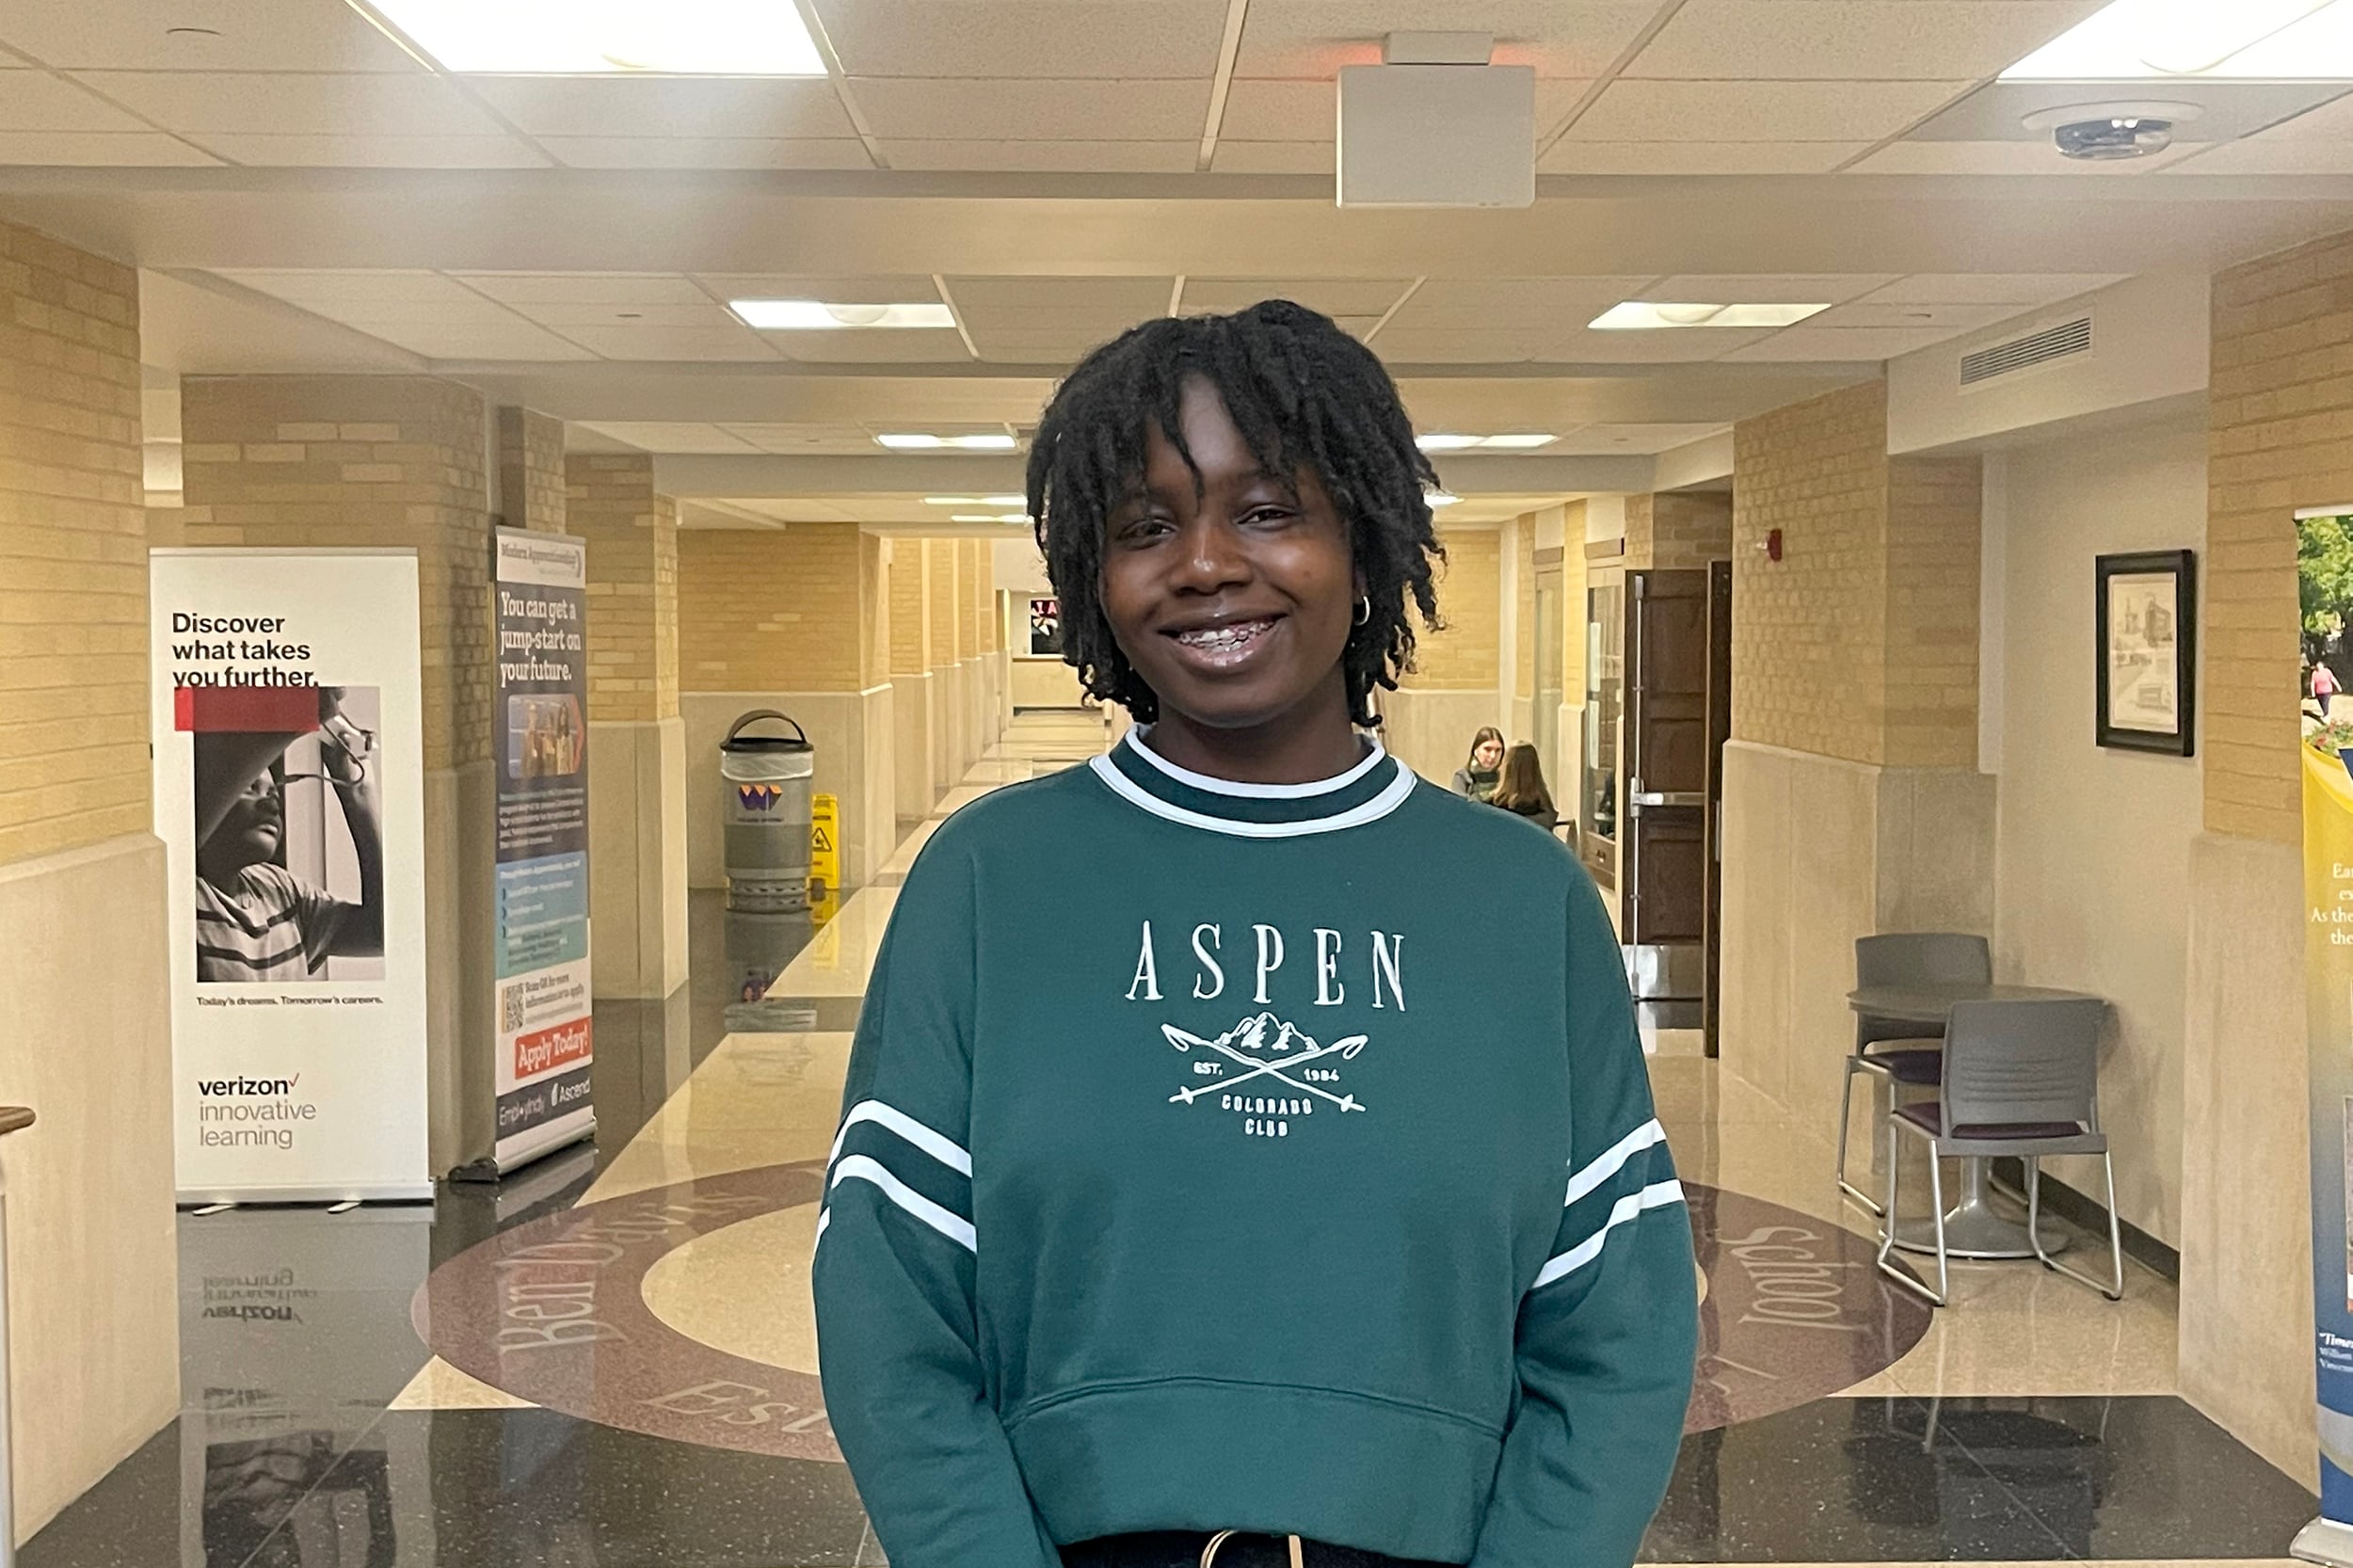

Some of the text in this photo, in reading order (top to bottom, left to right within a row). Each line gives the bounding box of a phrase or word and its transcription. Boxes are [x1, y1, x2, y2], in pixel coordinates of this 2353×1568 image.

[501, 591, 576, 626] You can get a
[172, 613, 285, 632] Discover
[172, 639, 311, 660] what takes
[501, 623, 581, 656] jump-start on
[172, 671, 218, 687] you
[500, 655, 572, 688] your future.
[2312, 906, 2329, 922] As
[1125, 919, 1406, 1012] ASPEN
[197, 997, 235, 1006] Today's
[280, 996, 340, 1005] Tomorrow's
[519, 1024, 588, 1071] Apply Today!
[198, 1075, 289, 1096] verizon
[200, 1099, 316, 1121] innovative
[1222, 1094, 1313, 1114] COLORADO
[200, 1125, 293, 1149] learning
[1244, 1118, 1289, 1137] CLUB
[1717, 1225, 1873, 1331] School
[498, 1282, 627, 1350] Ben
